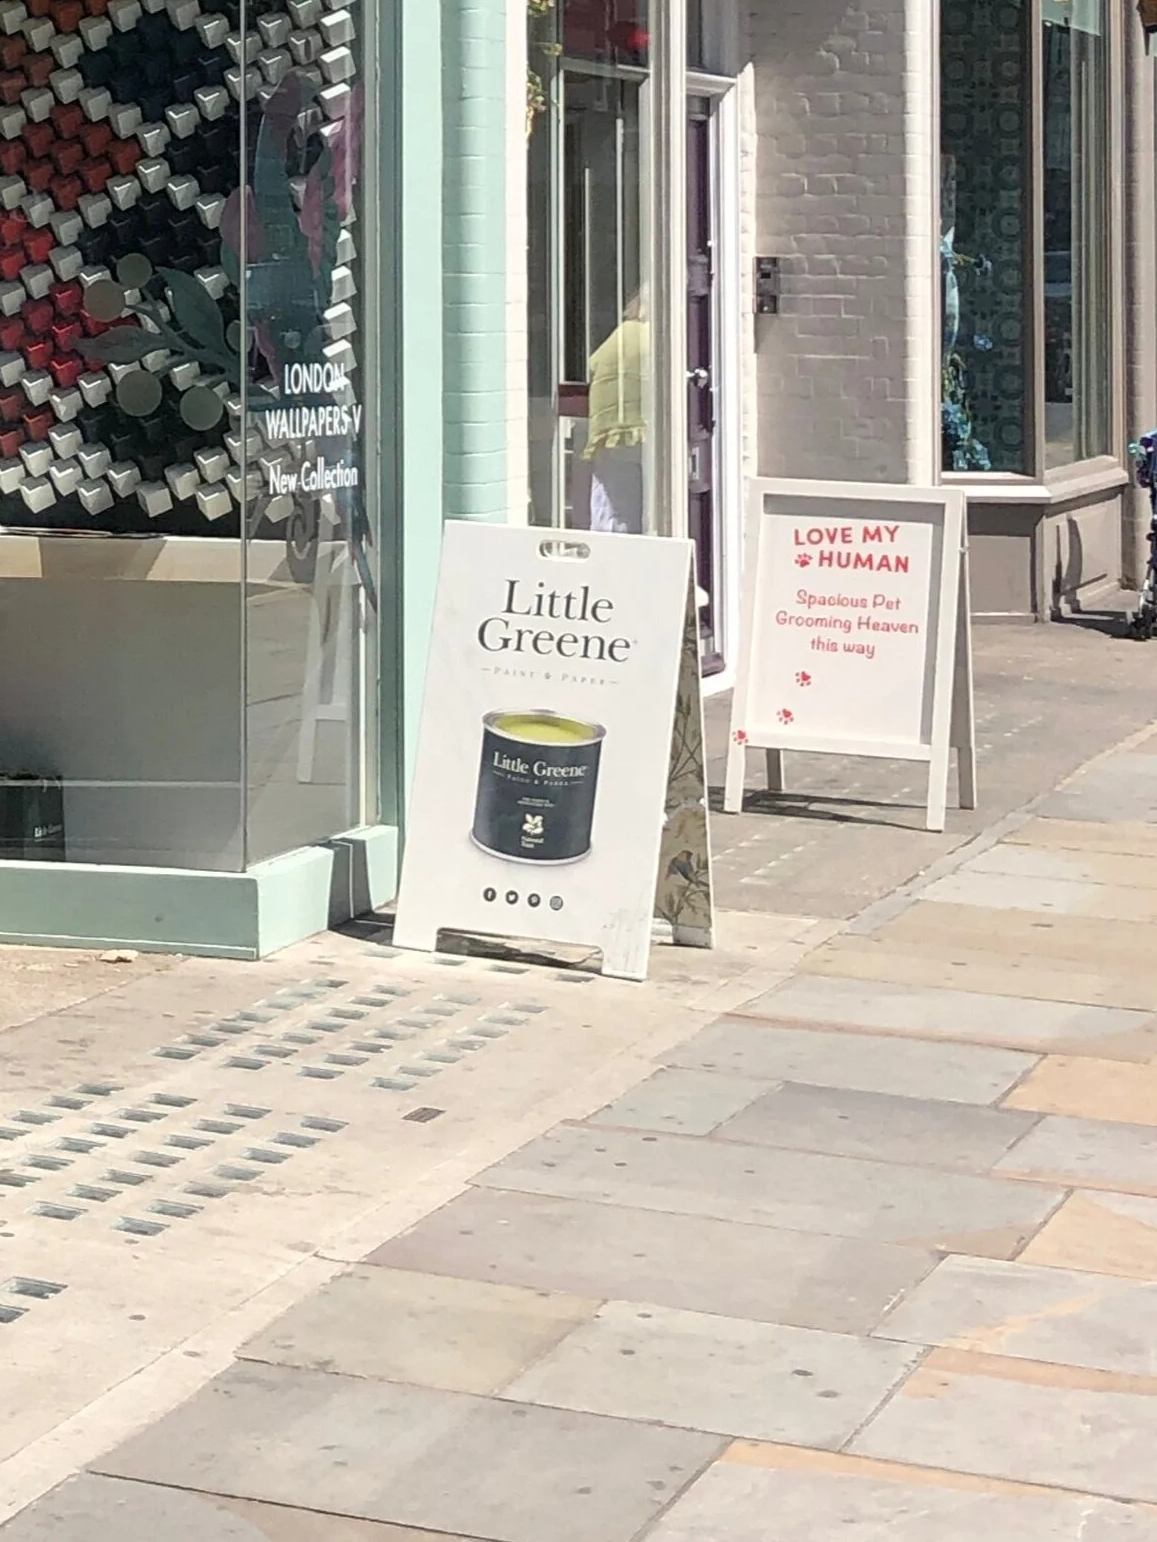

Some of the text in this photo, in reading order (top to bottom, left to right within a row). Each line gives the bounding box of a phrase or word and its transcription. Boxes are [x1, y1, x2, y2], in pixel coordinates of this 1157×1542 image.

[284, 362, 345, 394] LONDON
[265, 404, 362, 440] WALLPAPERS V
[269, 457, 359, 495] New Collection
[794, 525, 900, 546] LOVE MY
[818, 550, 909, 573] HUMAN
[501, 579, 614, 623] Little
[796, 589, 902, 610] Spacious Pet
[775, 610, 919, 634] Grooming Heaven
[477, 617, 631, 663] Greene
[810, 635, 875, 659] this way
[493, 751, 586, 778] Little Greene
